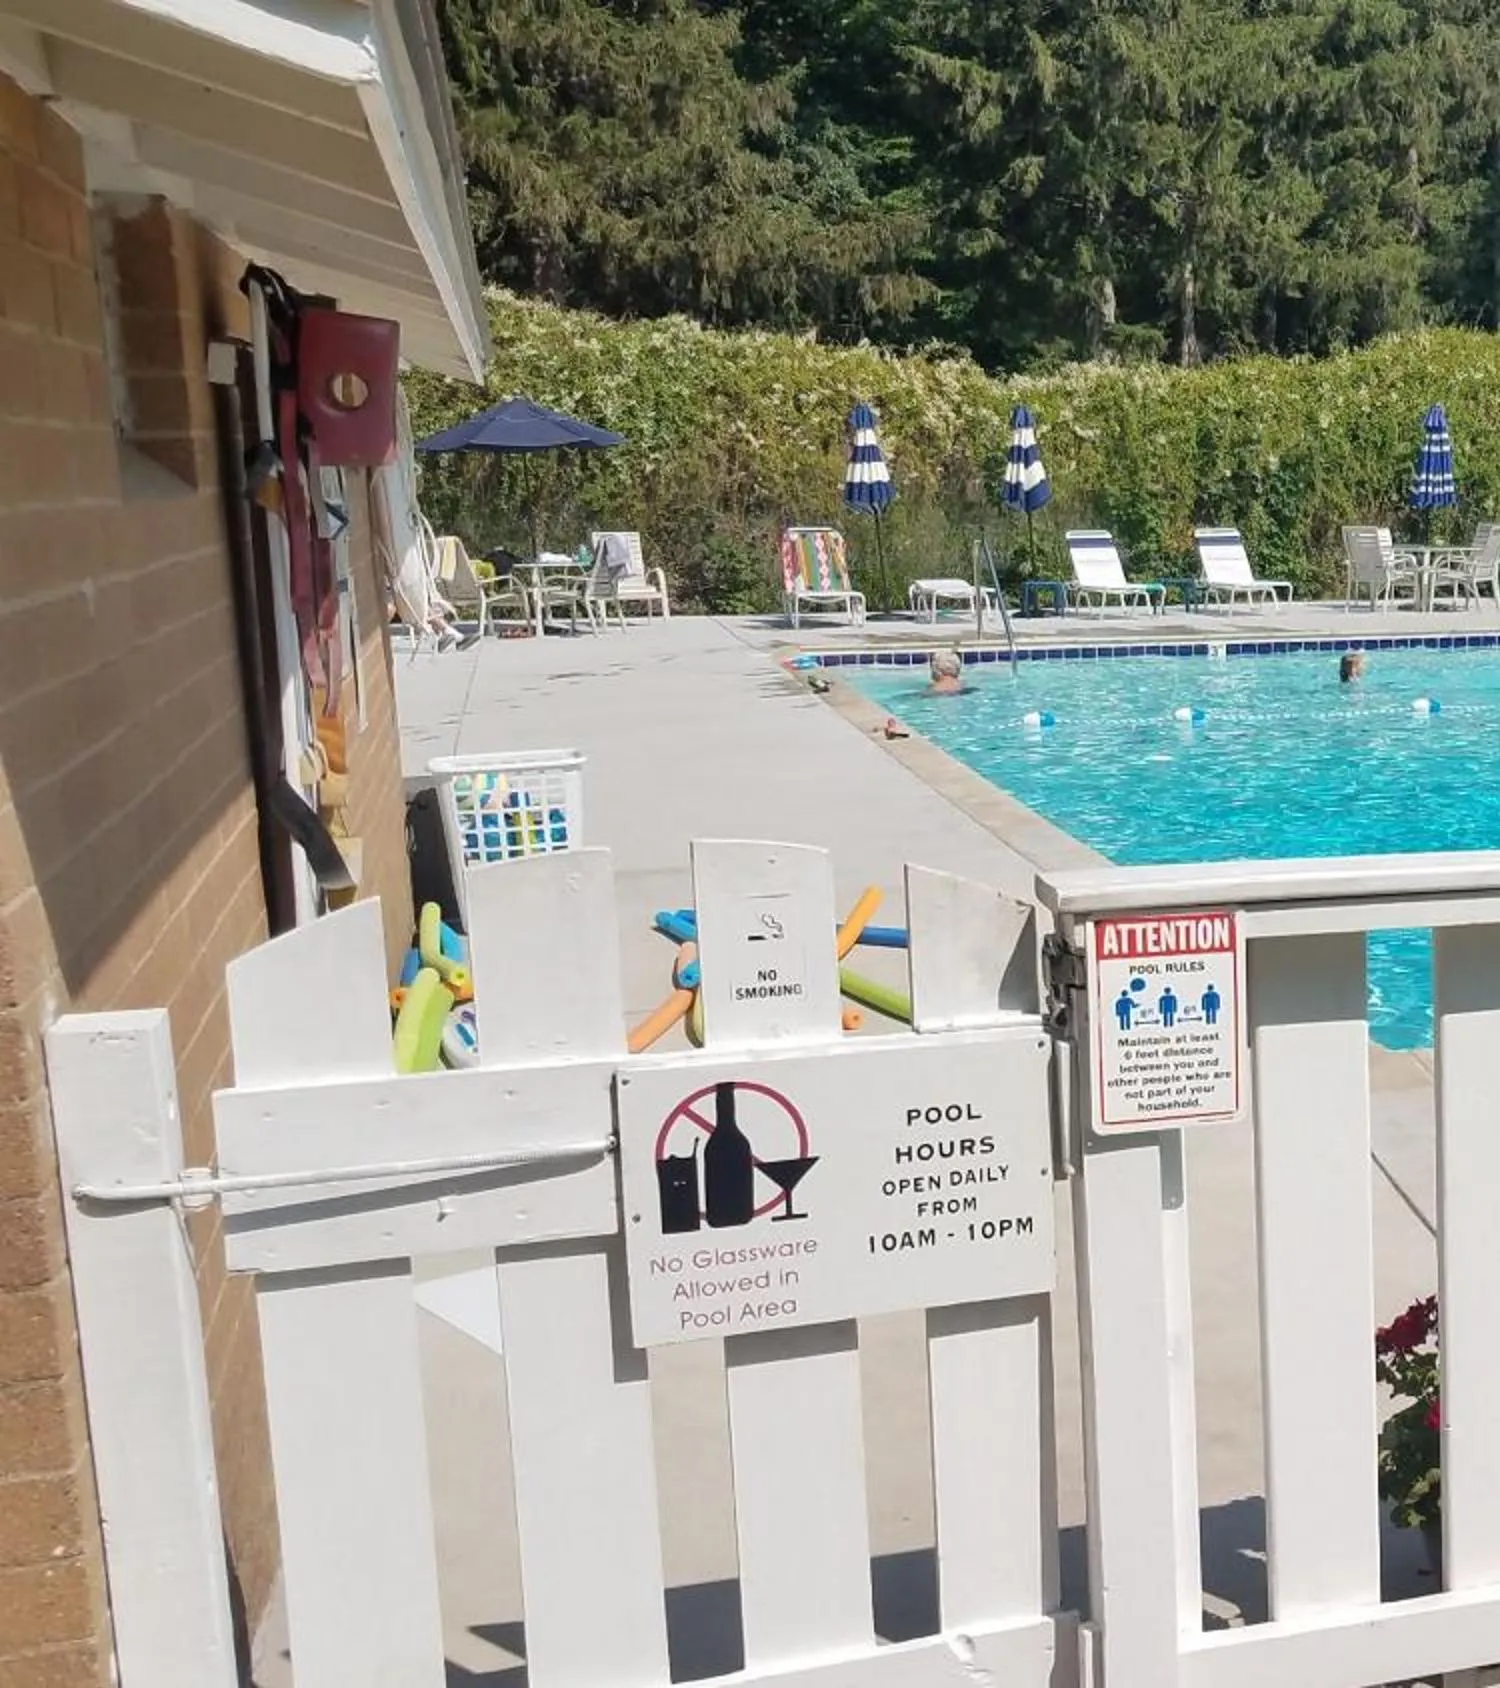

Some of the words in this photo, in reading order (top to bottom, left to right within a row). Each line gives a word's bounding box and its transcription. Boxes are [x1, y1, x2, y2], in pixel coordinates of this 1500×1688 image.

[1103, 917, 1230, 955] ATTENTION
[757, 969, 777, 981] NO
[1129, 964, 1162, 974] POOL
[1165, 961, 1205, 973] RULES
[735, 983, 802, 1001] SMOKING
[1117, 1036, 1171, 1047] Maintain
[1190, 1032, 1219, 1043] least
[1124, 1051, 1132, 1060] 6
[1135, 1050, 1159, 1059] feet
[1162, 1047, 1214, 1057] distance
[1119, 1064, 1170, 1073] between
[1173, 1062, 1195, 1071] you
[1198, 1058, 1219, 1067] and
[1107, 1078, 1137, 1088] other
[1142, 1074, 1182, 1086] people
[1186, 1073, 1210, 1081] who
[1213, 1071, 1232, 1079] are
[1124, 1090, 1144, 1099] not
[1147, 1088, 1172, 1099] part
[1175, 1086, 1187, 1095] of
[1190, 1085, 1215, 1095] your
[907, 1103, 982, 1126] POOL
[1137, 1099, 1203, 1112] household.
[895, 1136, 995, 1164] HOURS
[882, 1175, 942, 1196] OPEN
[950, 1164, 1009, 1186] DAILY
[917, 1197, 977, 1217] FROM
[869, 1229, 936, 1253] 10AM
[968, 1216, 1034, 1241] 10PM
[650, 1256, 683, 1275] No
[693, 1239, 818, 1269] Glassware
[673, 1270, 770, 1301] Allowed
[779, 1269, 799, 1285] in
[680, 1305, 731, 1329] Pool
[739, 1299, 797, 1321] Area
